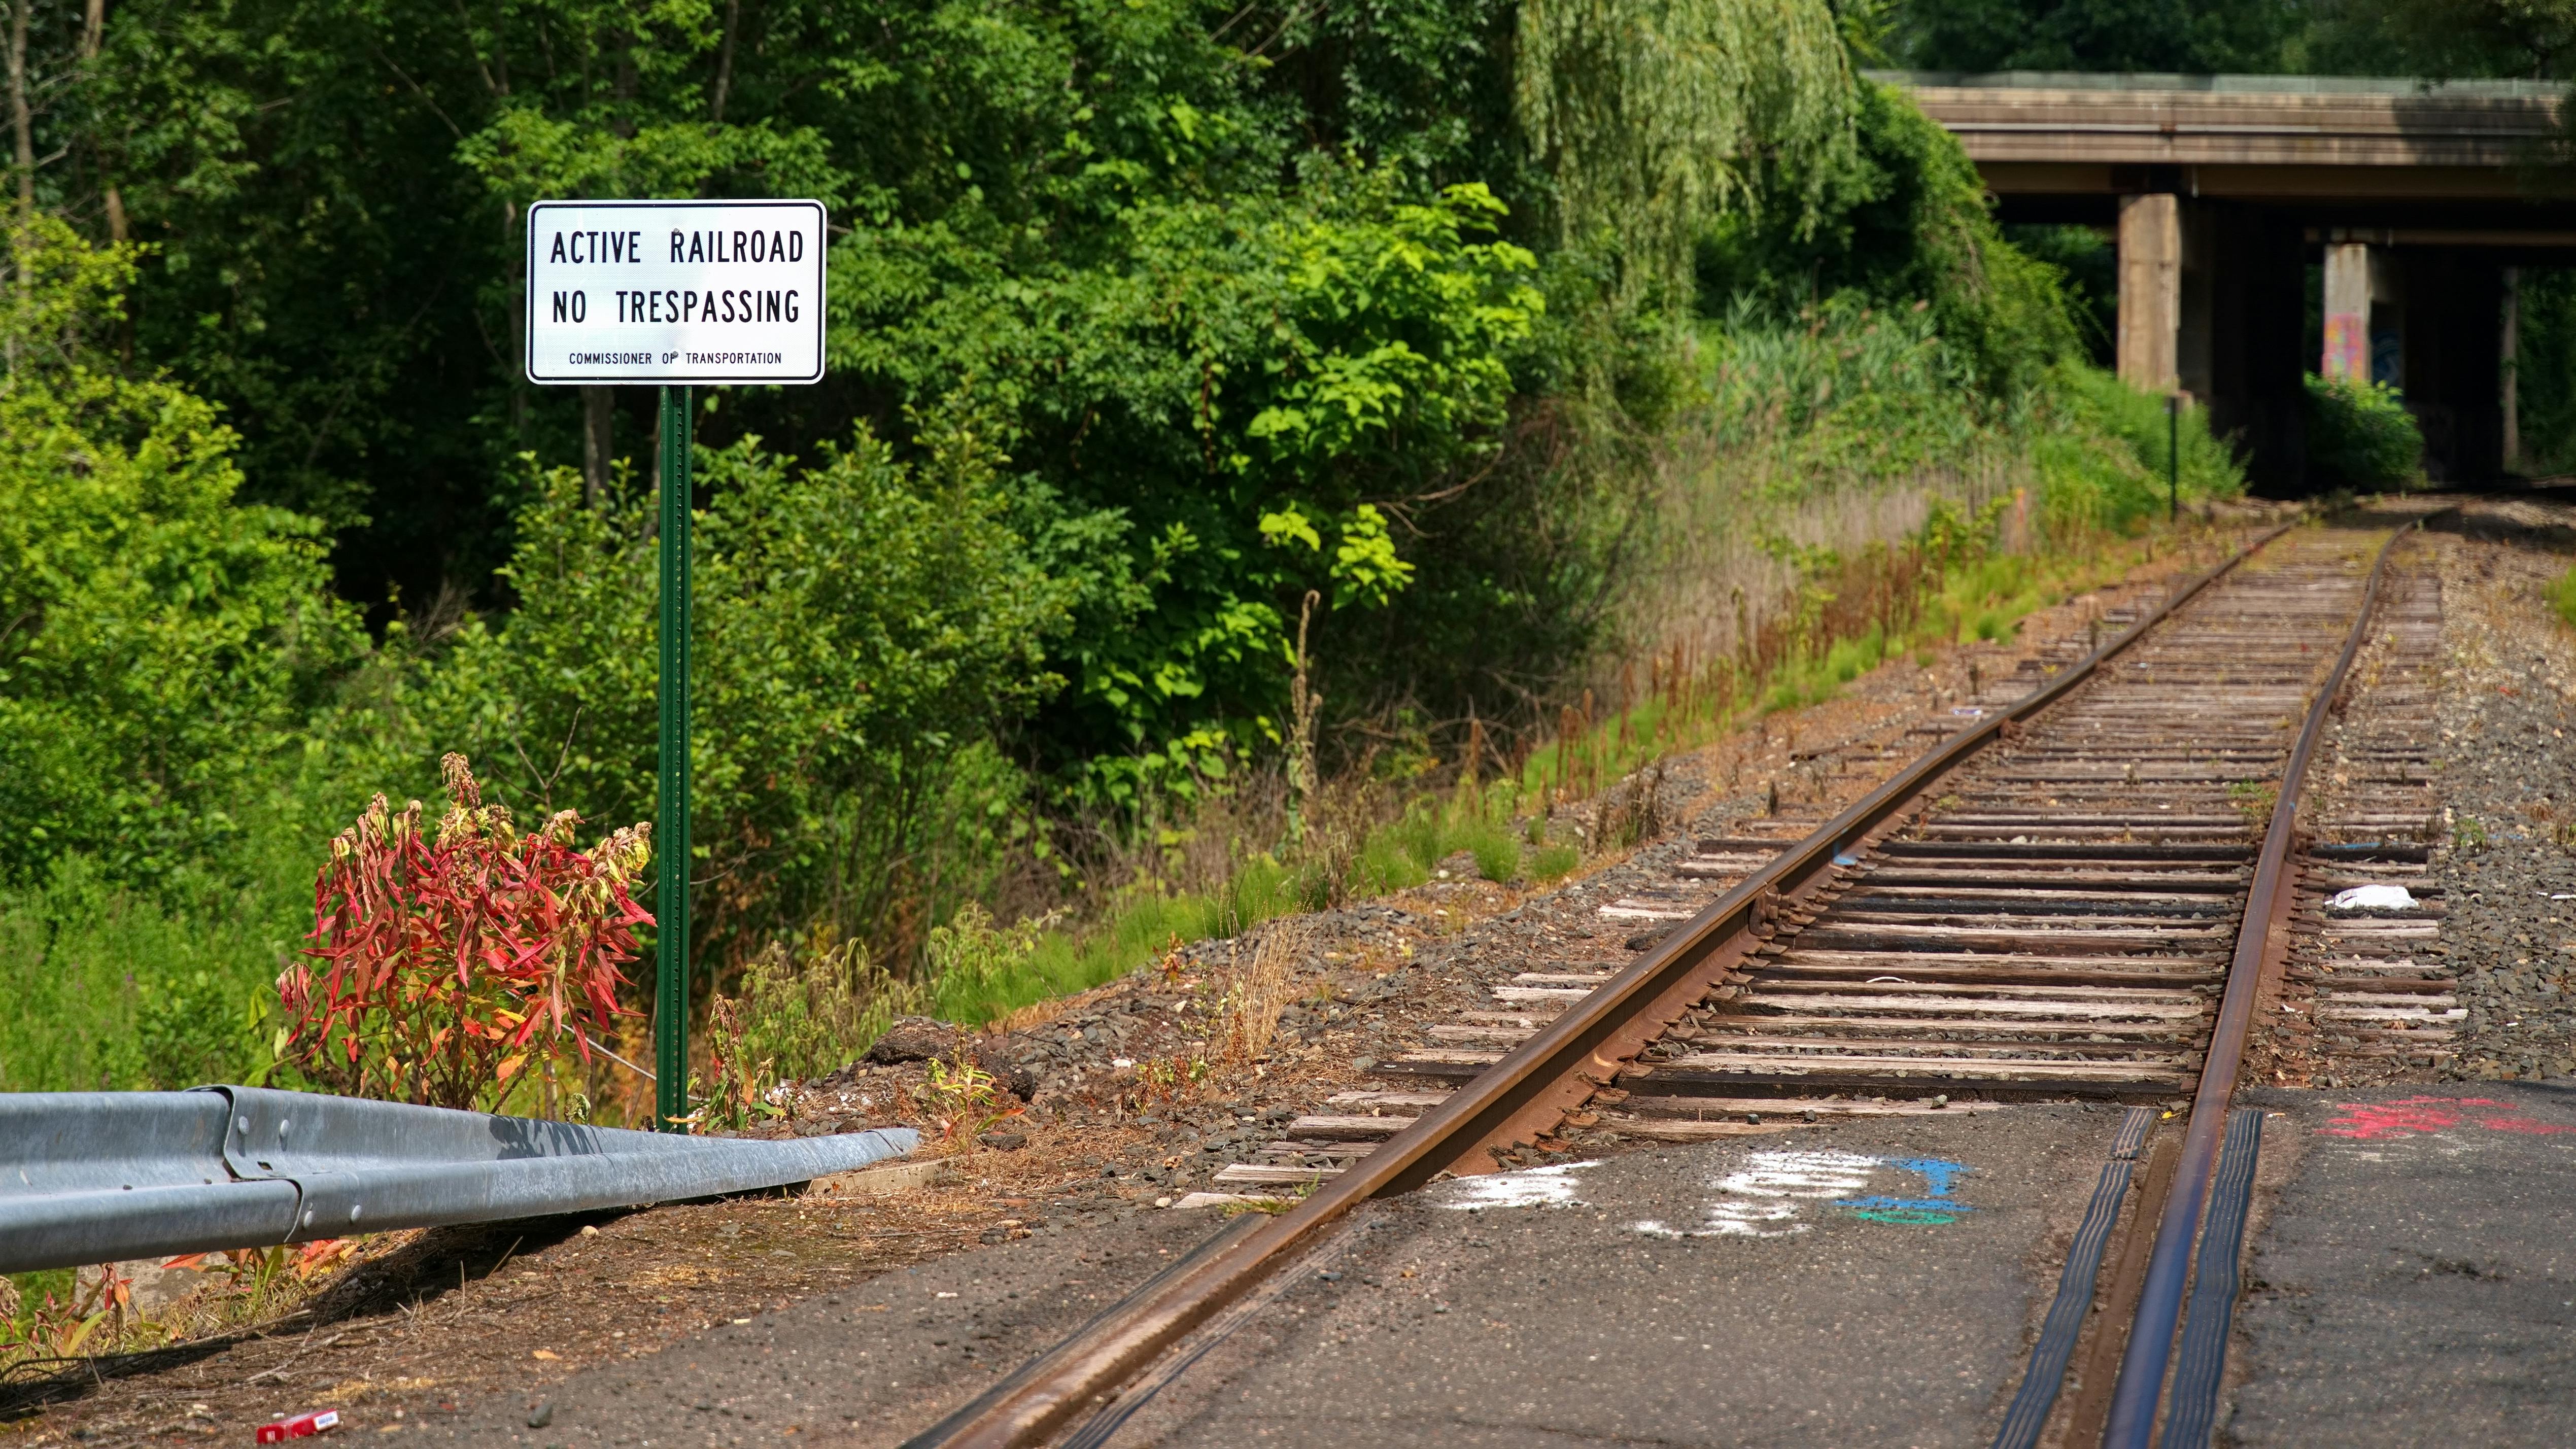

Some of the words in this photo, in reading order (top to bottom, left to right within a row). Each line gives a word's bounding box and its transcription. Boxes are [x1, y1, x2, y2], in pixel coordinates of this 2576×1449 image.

[550, 231, 641, 264] ACTIVE
[671, 230, 803, 263] RAILROAD
[553, 290, 586, 323] NO
[615, 290, 799, 323] TRESPASSING
[569, 353, 652, 364] COMMISSIONER
[662, 353, 677, 364] OF
[685, 352, 781, 364] TRANSPORTATION
